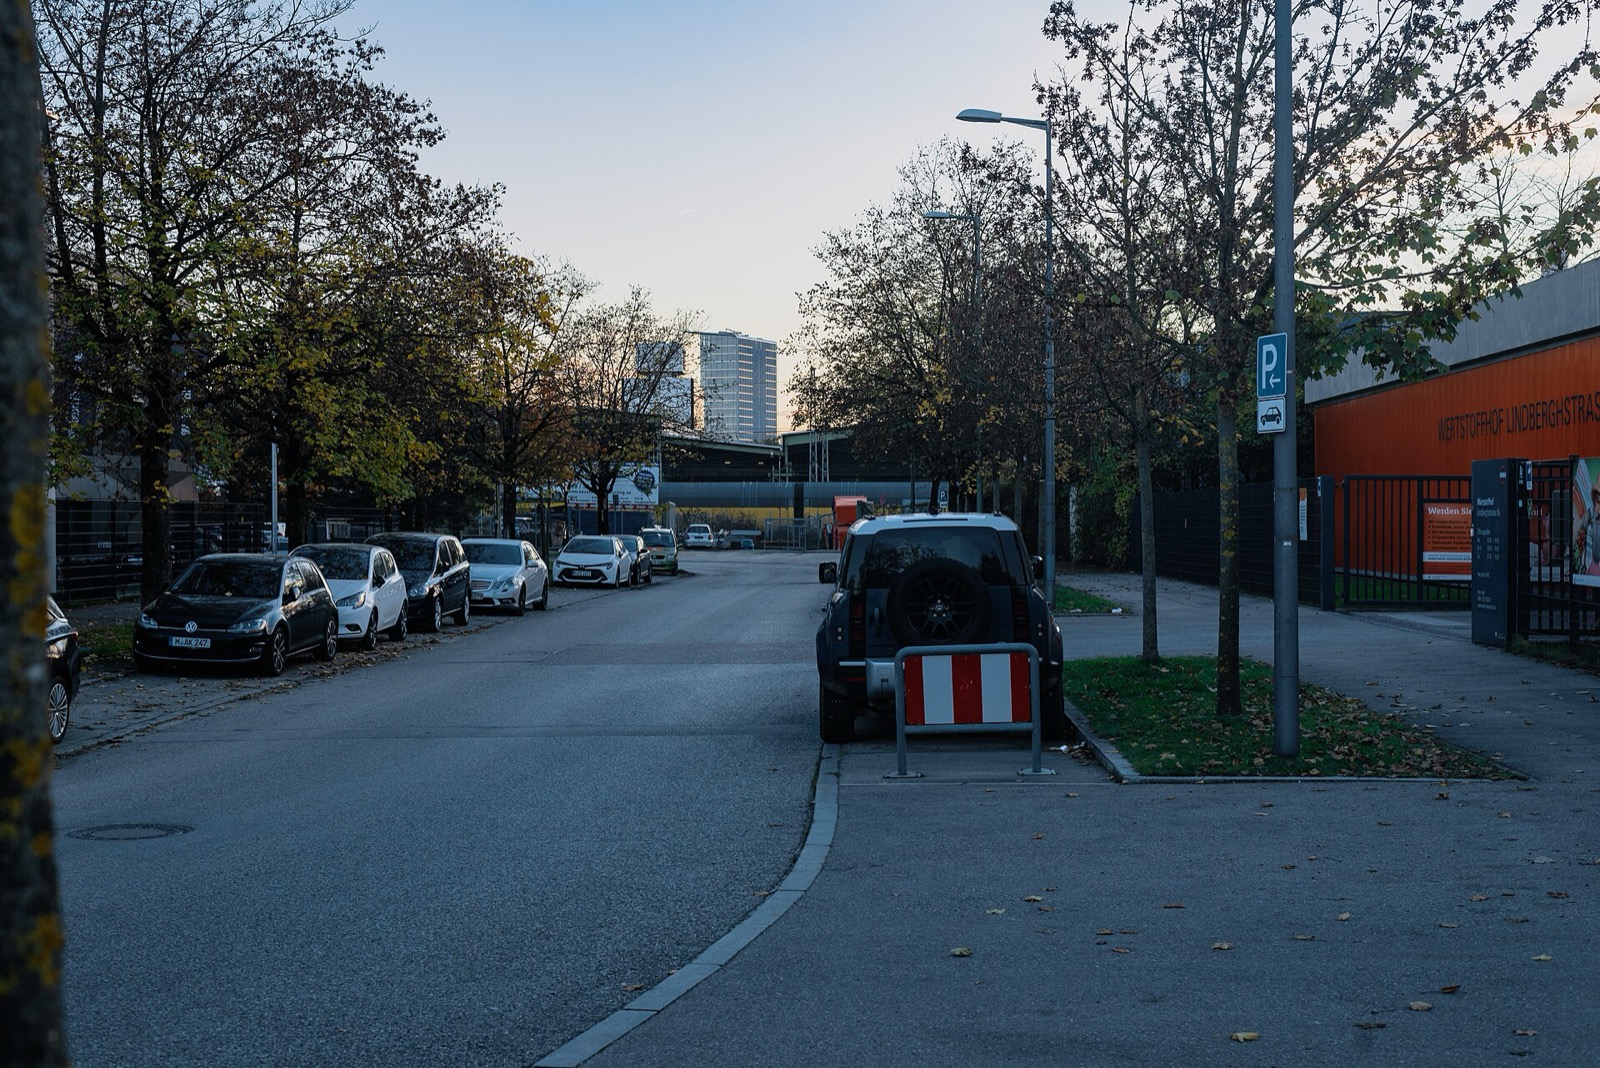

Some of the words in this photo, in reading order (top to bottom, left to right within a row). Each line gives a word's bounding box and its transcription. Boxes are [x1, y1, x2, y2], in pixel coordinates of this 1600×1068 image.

[1262, 344, 1277, 389] P
[1437, 408, 1504, 442] WERTSTOFFHOF
[940, 491, 946, 500] P
[1428, 507, 1459, 515] Werden
[194, 639, 208, 647] 247
